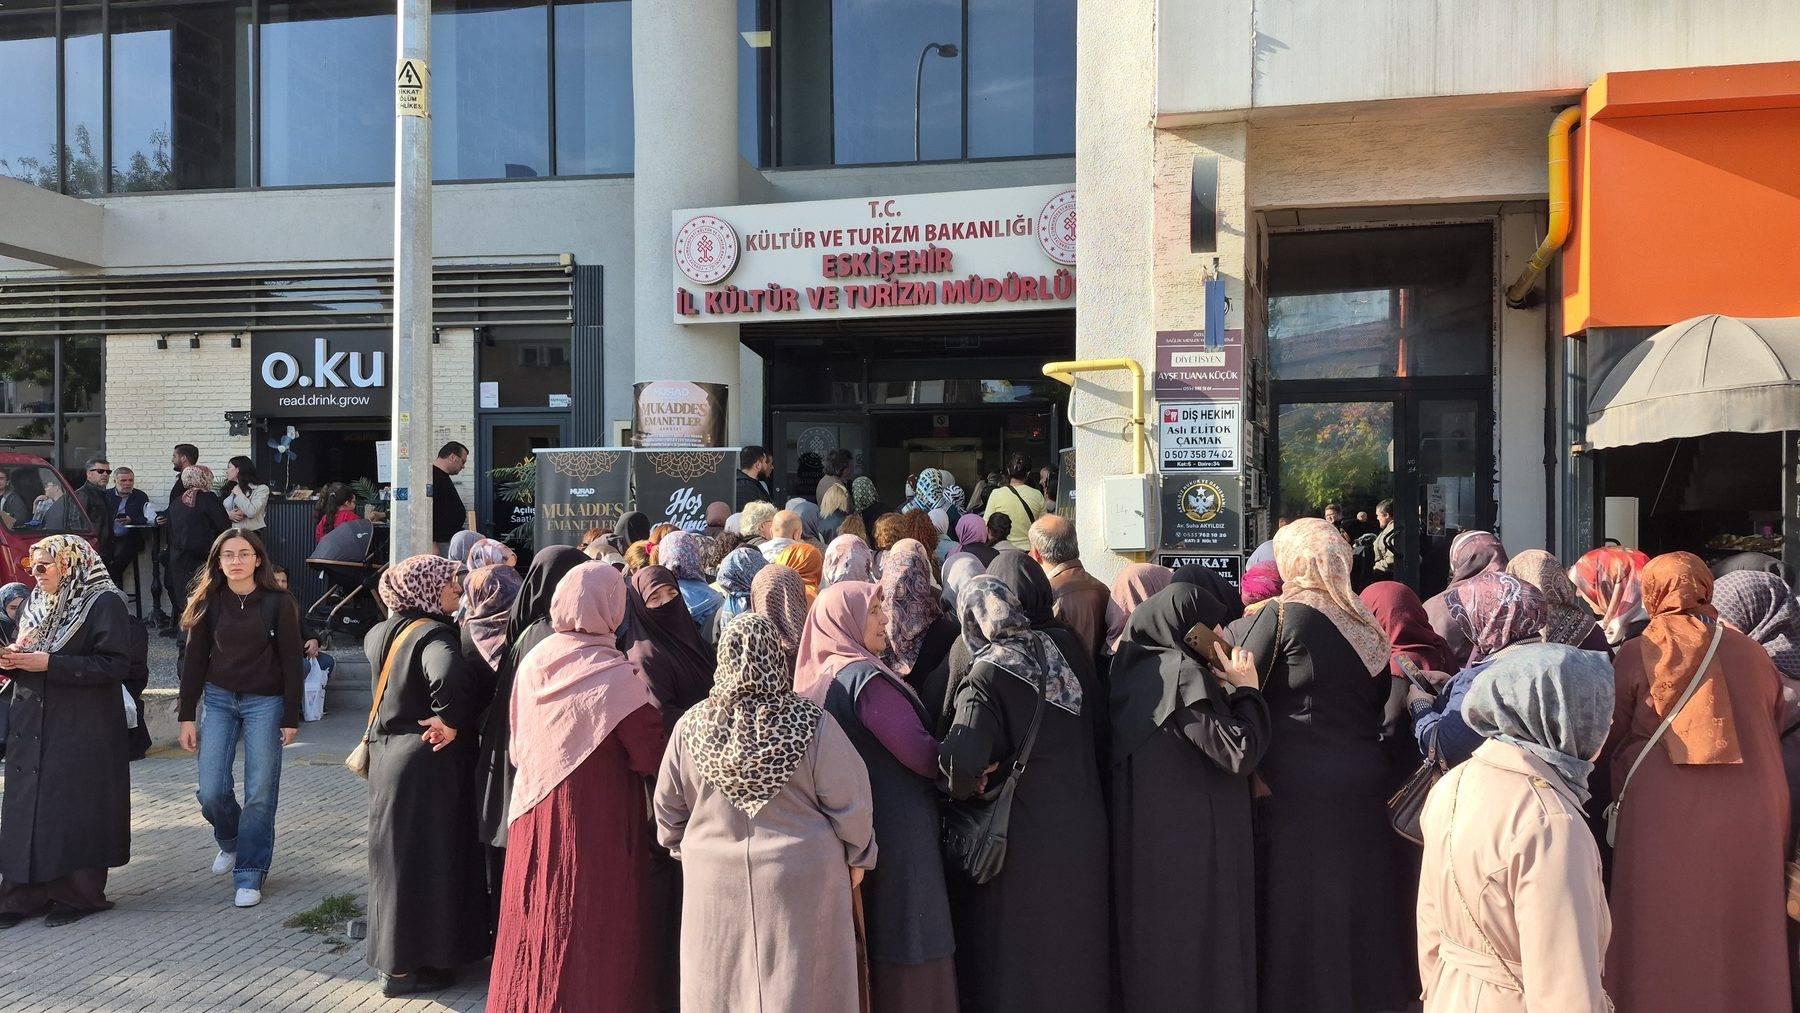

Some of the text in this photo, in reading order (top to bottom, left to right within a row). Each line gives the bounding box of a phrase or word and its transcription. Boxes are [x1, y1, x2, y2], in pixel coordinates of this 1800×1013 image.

[868, 200, 902, 219] T.C.
[745, 227, 817, 252] KÜLTÜR
[820, 229, 843, 248] VE
[847, 222, 920, 246] TURİZM
[925, 215, 1033, 242] BAKANLIĞI
[822, 243, 953, 282] ESKİŞEHİR
[676, 268, 1076, 316] İL KÜLTÜR VE TURİZM MÜDÜRLÜ
[261, 337, 385, 389] o.ku
[1158, 370, 1238, 381] AYŞE TUANA KÜÇÜK
[279, 394, 370, 408] read.drink.grow
[1182, 407, 1235, 422] DİŞ HEKİMİ
[1167, 423, 1231, 435] Aslı ELİTOK
[1176, 436, 1222, 447] ÇAKMAK
[1164, 450, 1233, 459] 0 507 358 74 02
[542, 502, 624, 519] MUKADDES
